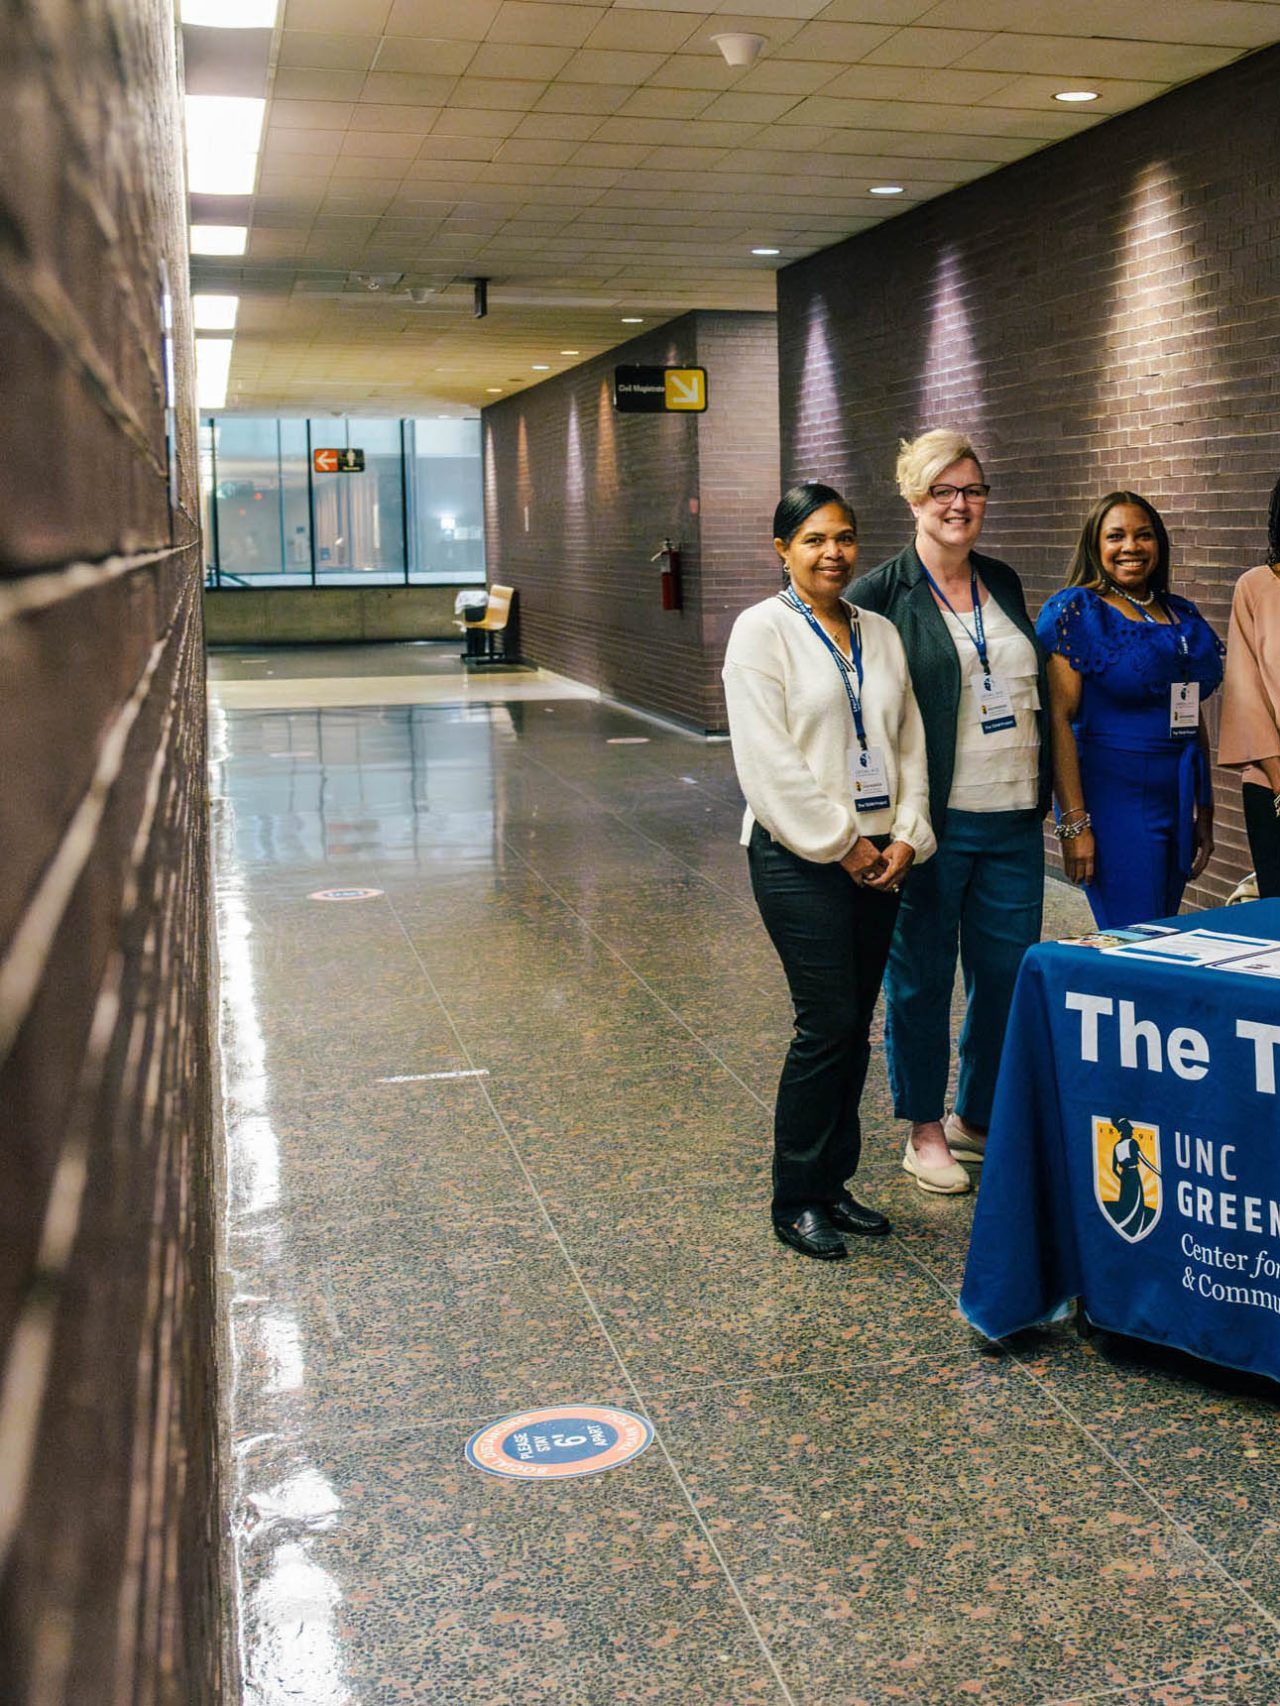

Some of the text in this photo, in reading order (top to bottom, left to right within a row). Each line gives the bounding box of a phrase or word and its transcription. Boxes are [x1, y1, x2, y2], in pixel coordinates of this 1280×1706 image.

[1065, 991, 1210, 1081] The
[1174, 1131, 1237, 1181] UNC
[1181, 1233, 1249, 1271] Center
[1182, 1266, 1196, 1292] &
[514, 1432, 534, 1460] PLEASE
[533, 1435, 550, 1453] STAY
[586, 1424, 608, 1447] APART
